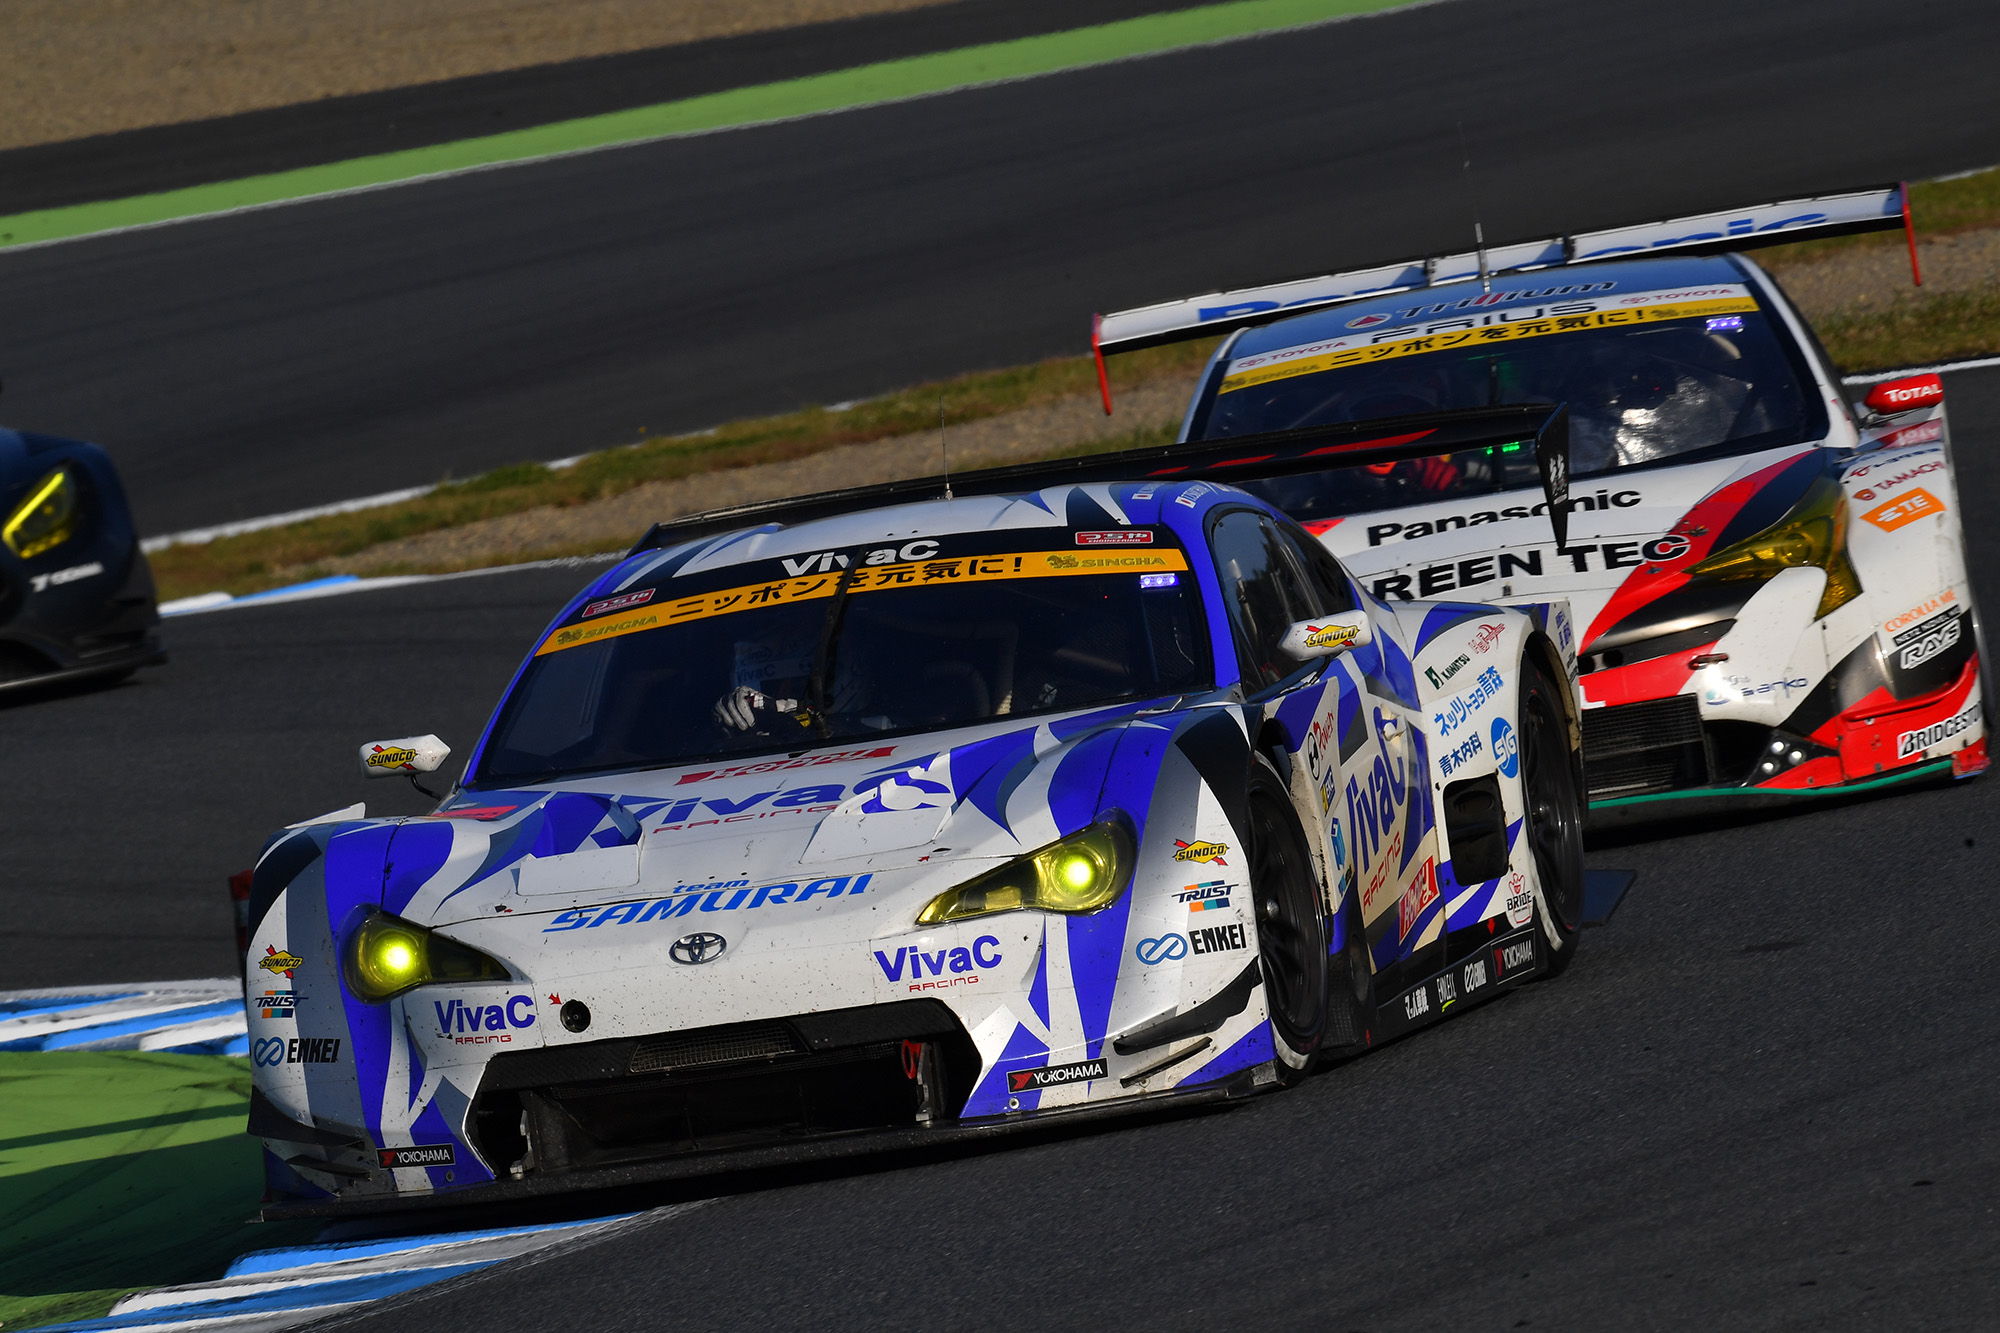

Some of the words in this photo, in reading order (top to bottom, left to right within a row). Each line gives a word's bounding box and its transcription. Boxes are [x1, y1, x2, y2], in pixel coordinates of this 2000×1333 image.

[1653, 288, 1734, 301] TOYOTA
[1371, 302, 1598, 344] PRIUS
[1268, 341, 1348, 361] TOYOTA
[1884, 384, 1943, 402] TOTAL
[1368, 489, 1641, 547] Panasonic
[781, 540, 940, 577] VivaC
[1081, 557, 1167, 568] SINGHA
[1373, 550, 1543, 602] REEN
[1557, 535, 1691, 573] TEC
[582, 615, 659, 639] SINGHA
[1884, 599, 1942, 632] COROLLA
[1306, 626, 1359, 647] SUNOCO
[1441, 653, 1471, 680] KAWATSU
[1434, 665, 1504, 736] ネッツトヨタ青森
[368, 749, 416, 766] SUNOCO
[1439, 731, 1483, 778] 青木内科
[653, 804, 839, 835] RACING
[1176, 845, 1227, 861] SUNOCO
[1363, 831, 1401, 915] RACING
[673, 879, 750, 895] team
[1171, 884, 1239, 903] TRUST
[542, 873, 874, 933] SAMURAI
[1506, 890, 1533, 911] BRIDE
[1188, 923, 1248, 955] ENKEI
[260, 957, 302, 969] SUNOCO
[873, 935, 1003, 982] VivaC
[1502, 940, 1534, 970] YOKOHAMA
[909, 975, 979, 993] RACING
[255, 996, 309, 1008] TRUST
[434, 994, 536, 1034] VivaC
[286, 1038, 341, 1064] ENKEI
[455, 1034, 512, 1045] RACING
[1033, 1063, 1104, 1086] YOKOHAMA
[396, 1148, 451, 1164] YOKOHAMA
